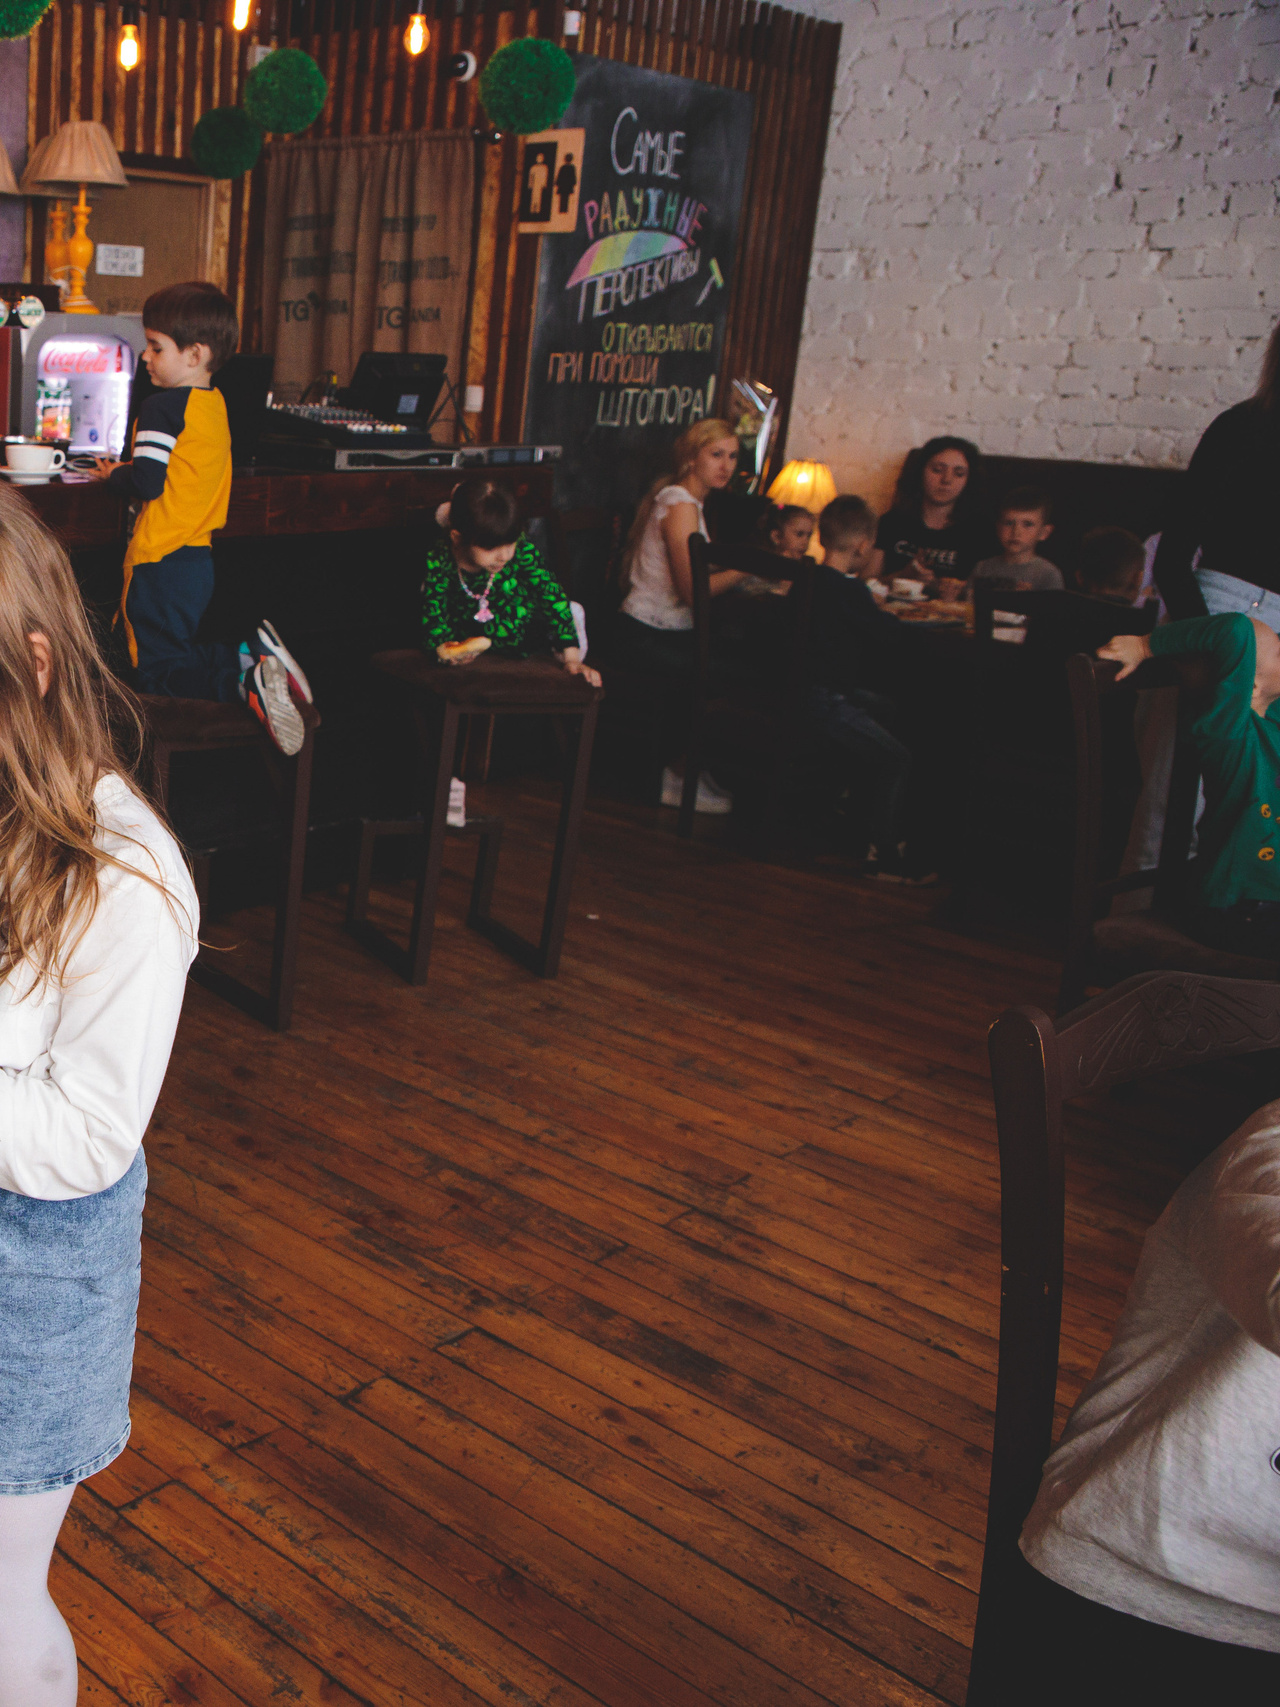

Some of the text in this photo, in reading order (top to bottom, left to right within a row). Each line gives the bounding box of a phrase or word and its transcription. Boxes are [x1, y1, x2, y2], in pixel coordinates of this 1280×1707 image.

[610, 106, 686, 180] САМЫЕ
[584, 187, 708, 246] РАДУЖНЫЕ
[577, 248, 701, 323] ПЕРСПЕКТИВЫ
[602, 322, 713, 353] ОТКРЫВАЮТСЯ
[547, 353, 659, 384] ПРИ ПОМОЩИ
[596, 374, 716, 427] ШТОПОРА!
